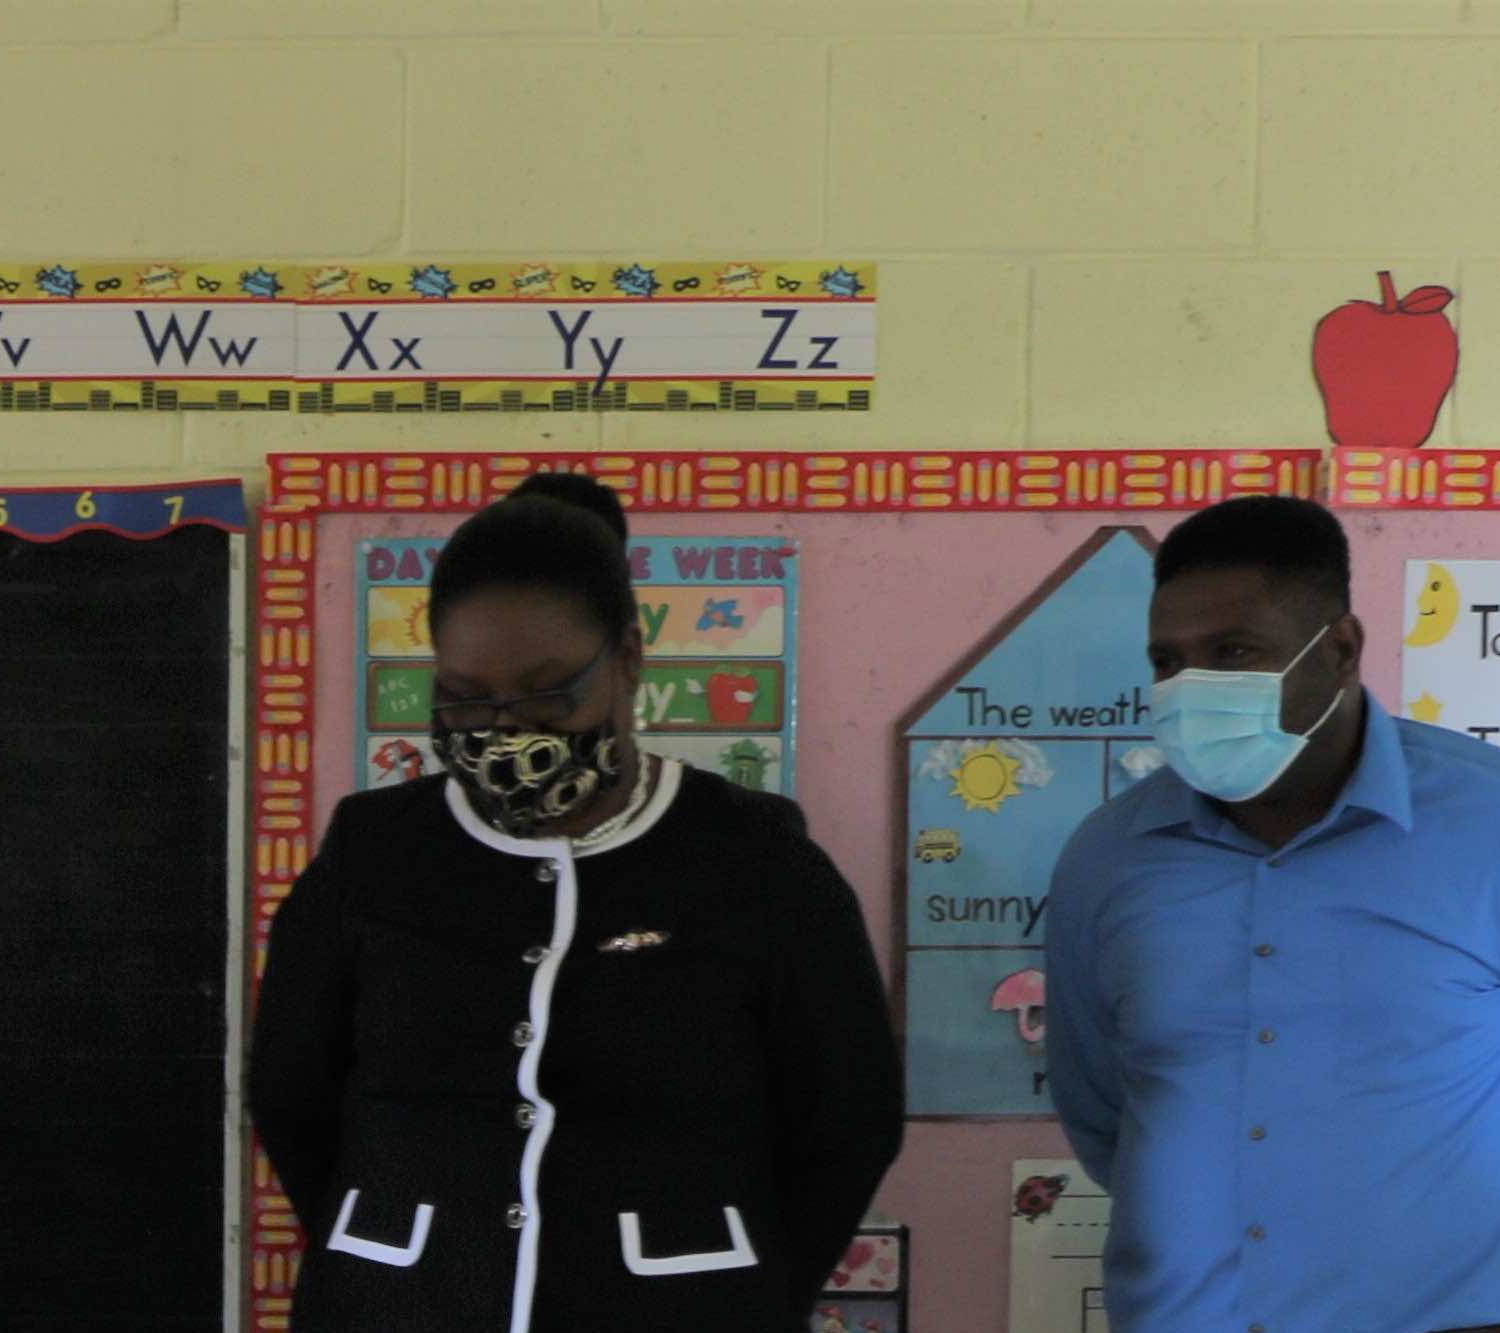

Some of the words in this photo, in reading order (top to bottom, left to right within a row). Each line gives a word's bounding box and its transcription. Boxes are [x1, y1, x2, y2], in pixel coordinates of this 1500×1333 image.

[135, 310, 257, 364] Ww
[337, 311, 422, 369] Xx
[548, 310, 624, 395] Yy
[759, 309, 838, 369] Zz
[76, 491, 96, 518] 6
[166, 496, 184, 523] 7
[672, 546, 785, 580] WEEK
[956, 686, 1033, 728] The
[927, 893, 1049, 939] sunny
